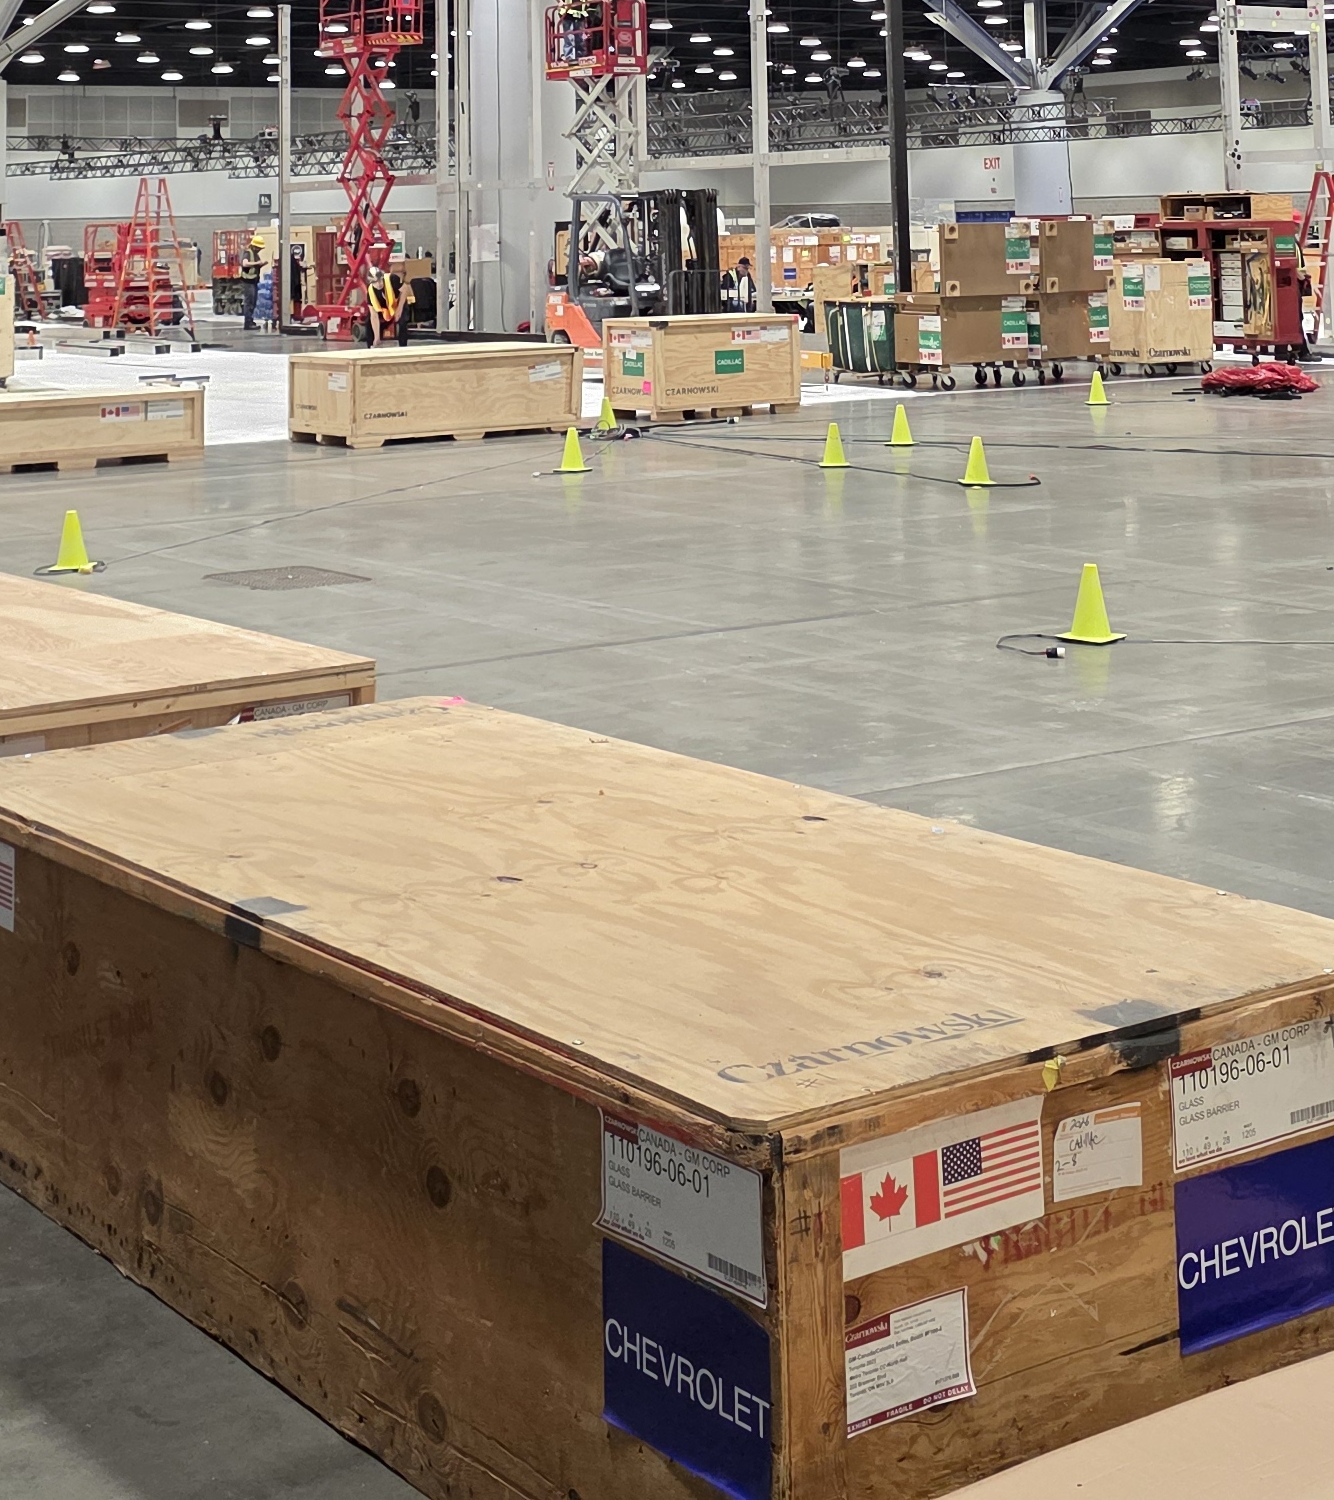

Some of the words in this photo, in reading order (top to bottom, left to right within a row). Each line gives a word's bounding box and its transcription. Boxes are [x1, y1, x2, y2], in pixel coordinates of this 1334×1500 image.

[984, 157, 1000, 170] EXIT
[716, 358, 742, 366] CADILLAC
[1148, 347, 1191, 358] Czarnowski
[665, 385, 719, 396] CZARNOWSKI
[363, 411, 408, 420] CZARNOWSKI
[253, 705, 287, 717] CANADA
[292, 703, 305, 712] GM
[306, 700, 329, 710] CORP
[716, 1008, 1019, 1084] Czarnowski
[1212, 1041, 1255, 1061] CANADA
[1263, 1032, 1280, 1047] GM
[1282, 1023, 1310, 1042] CORP
[1179, 1045, 1290, 1095] 110196-06-01
[1179, 1096, 1204, 1111] GLASS
[1179, 1109, 1205, 1126] GLASS
[1207, 1100, 1240, 1119] BARRIER
[639, 1128, 677, 1157] CANADA
[684, 1149, 700, 1167] GM
[702, 1156, 730, 1178] CORP
[609, 1160, 630, 1178] GLASS
[610, 1134, 710, 1198] 110196-06-01
[609, 1176, 631, 1195] GLASS
[632, 1186, 662, 1209] BARRIER
[845, 1322, 887, 1343] Czarnowski
[605, 1318, 770, 1439] CHEVROLET
[847, 1418, 872, 1432] EXHIBIT
[887, 1404, 913, 1418] FRAGILE
[933, 1391, 946, 1400] NOT
[948, 1384, 969, 1396] DELAY
